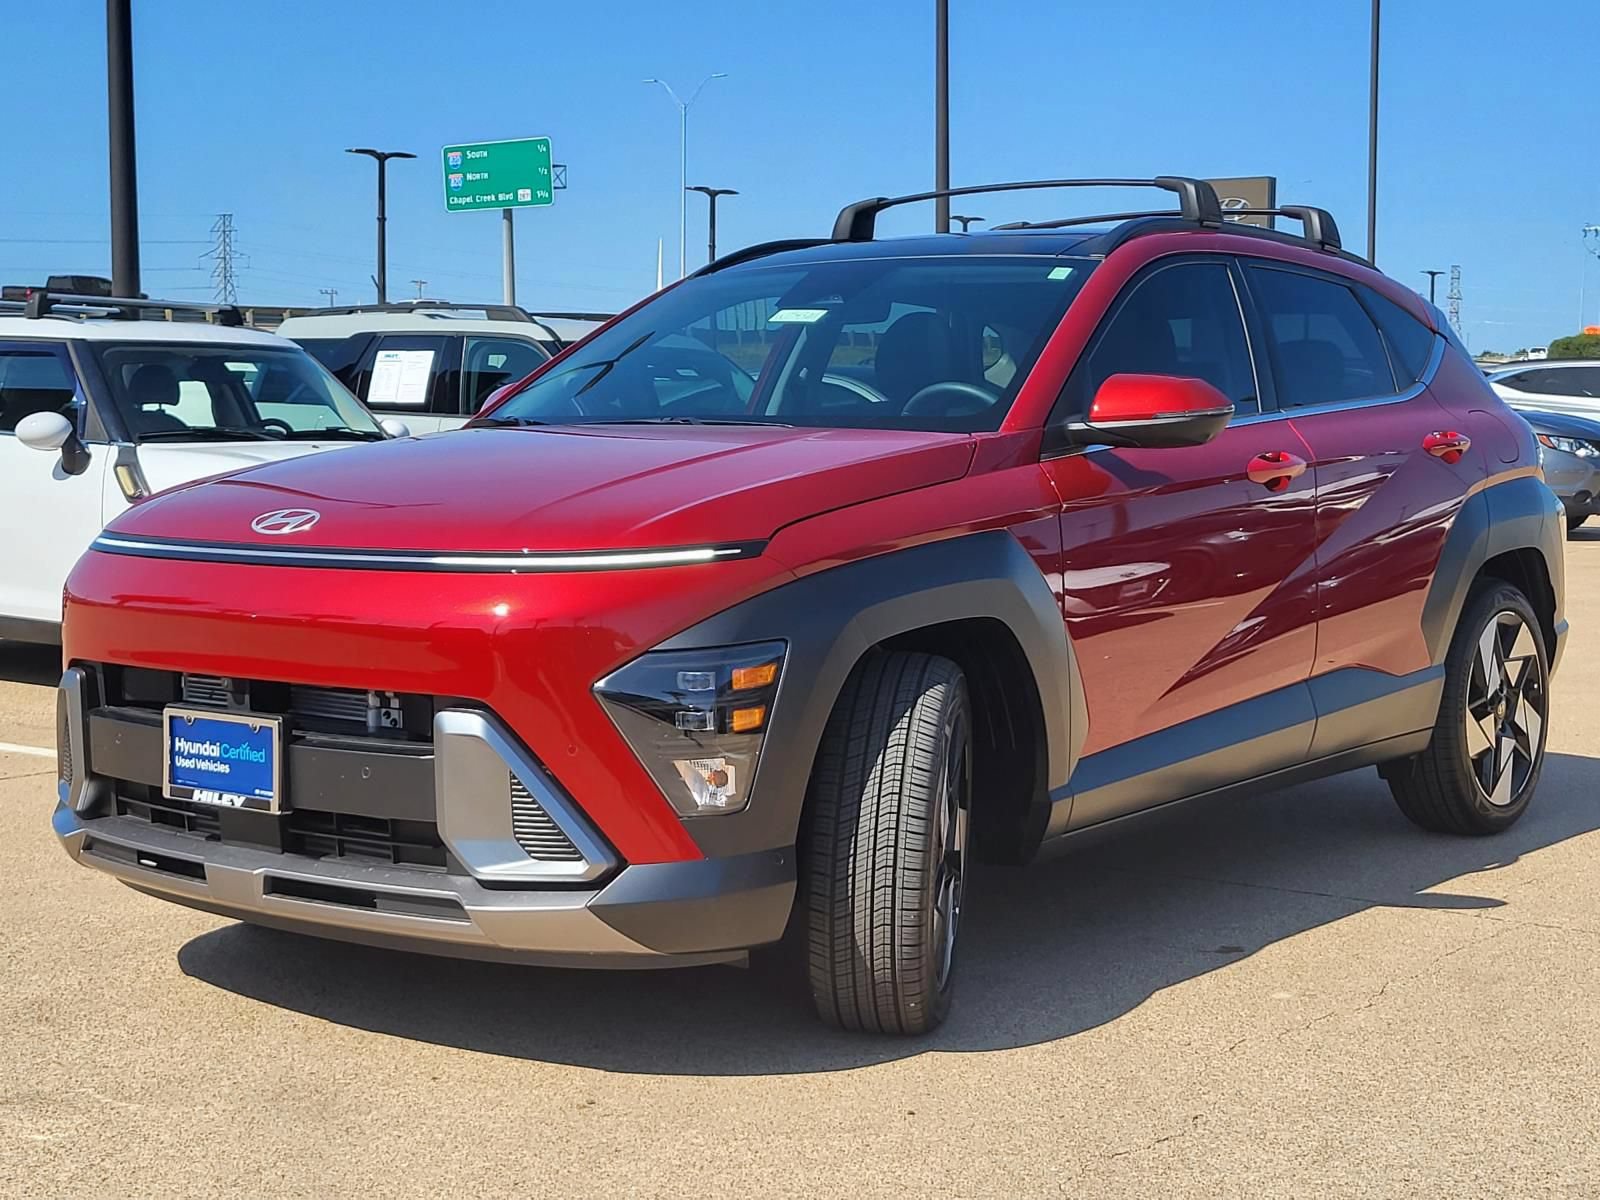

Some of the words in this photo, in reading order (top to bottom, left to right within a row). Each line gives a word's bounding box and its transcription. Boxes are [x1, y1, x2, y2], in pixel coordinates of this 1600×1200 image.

[449, 195, 473, 205] Chapel
[475, 194, 496, 202] Creek
[498, 192, 514, 201] Blvd
[175, 736, 220, 758] Hyundai
[220, 742, 265, 763] Certified
[175, 755, 195, 770] Used
[195, 758, 230, 774] Vehicles
[192, 788, 247, 807] HILEY
